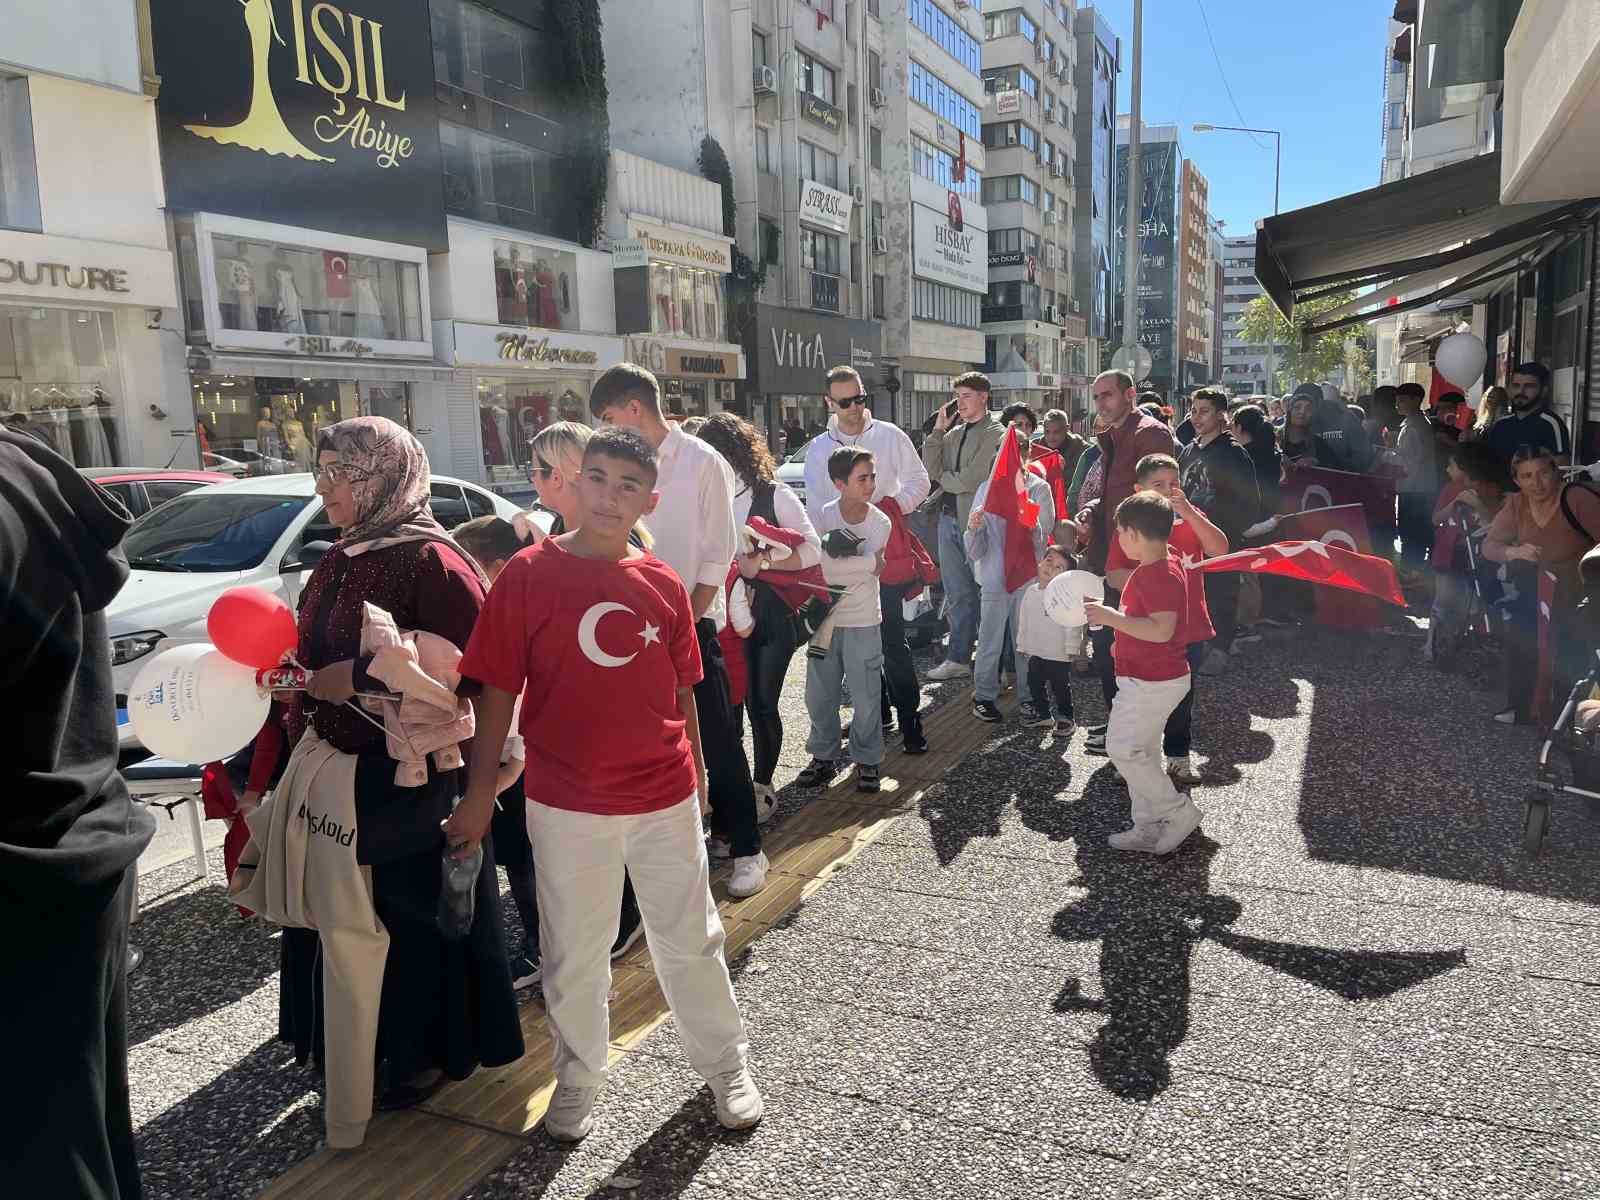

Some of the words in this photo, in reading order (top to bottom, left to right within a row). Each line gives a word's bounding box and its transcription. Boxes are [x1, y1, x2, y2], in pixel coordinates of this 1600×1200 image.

[314, 107, 415, 169] Abiye
[807, 188, 841, 215] STRASS
[1116, 223, 1169, 238] KSHA
